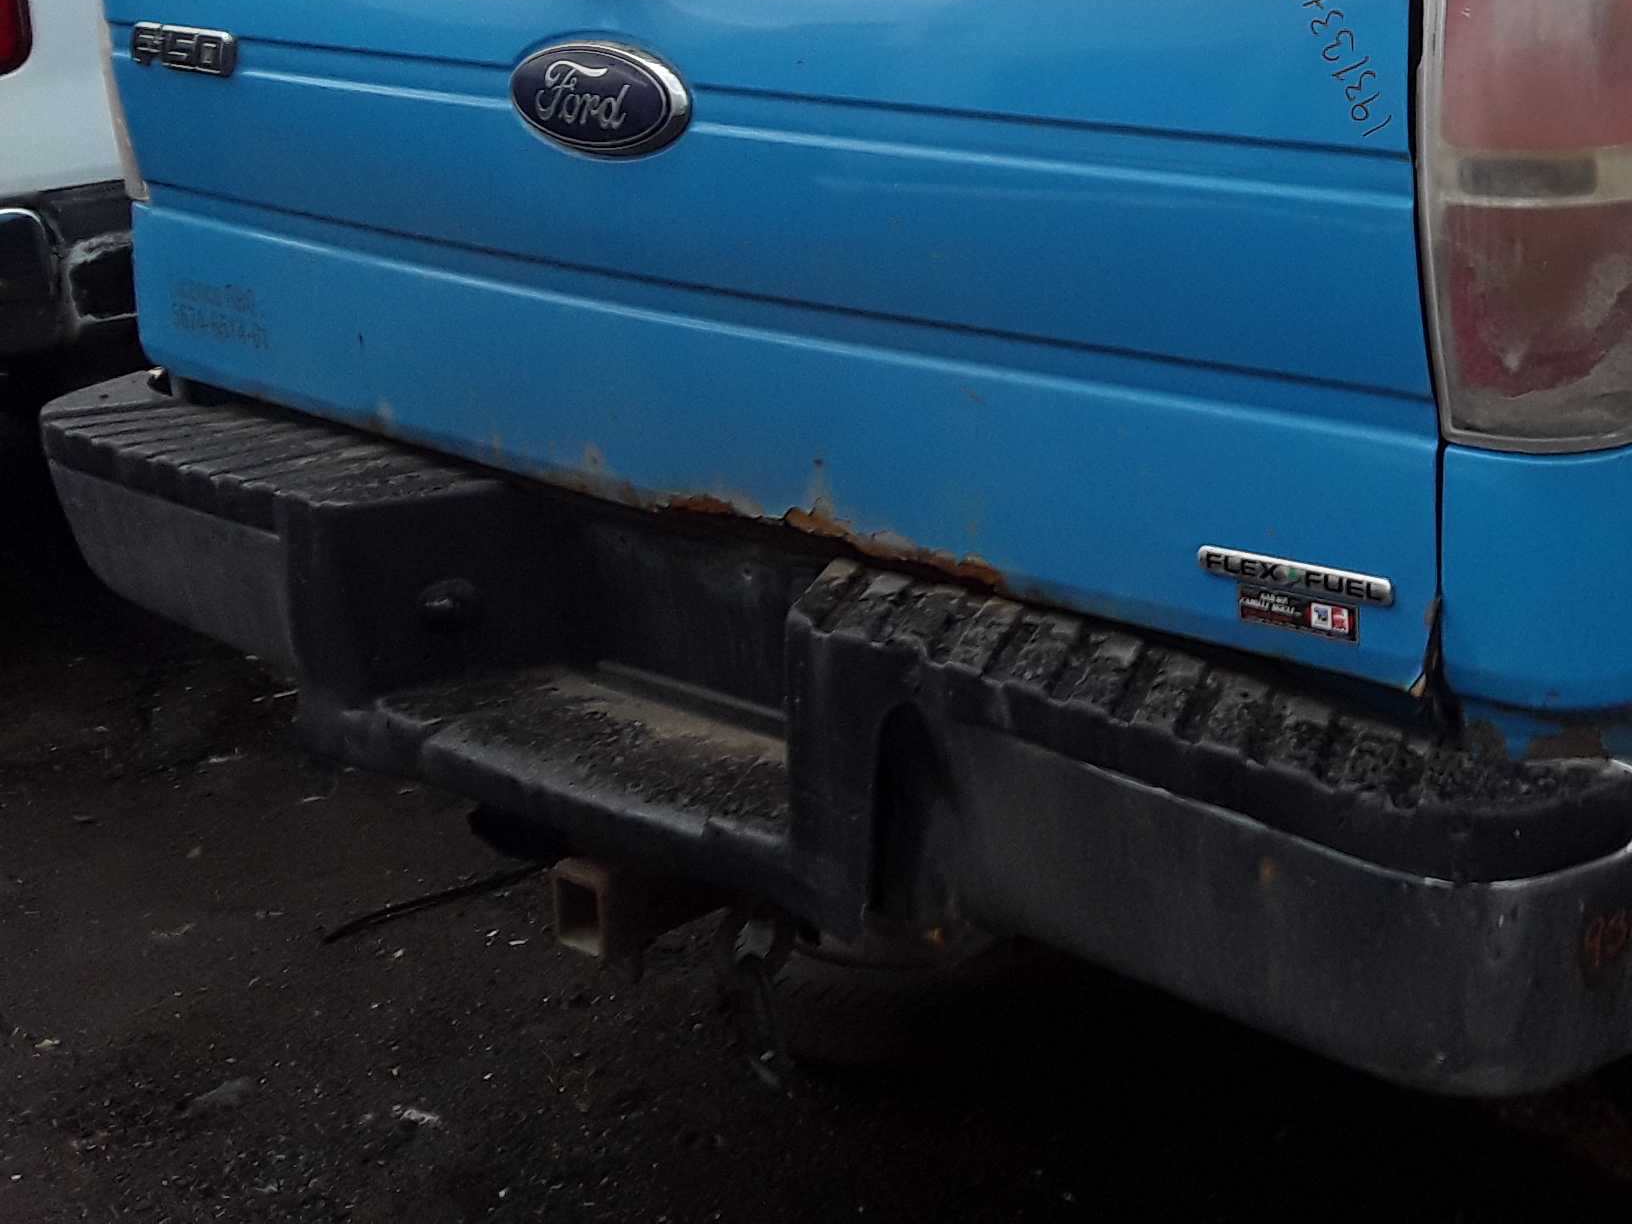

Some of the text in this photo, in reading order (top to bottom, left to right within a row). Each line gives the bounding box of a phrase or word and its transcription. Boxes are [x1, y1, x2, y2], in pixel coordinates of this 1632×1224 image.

[536, 60, 631, 130] Ford
[1205, 551, 1384, 602] FLEX FUEL
